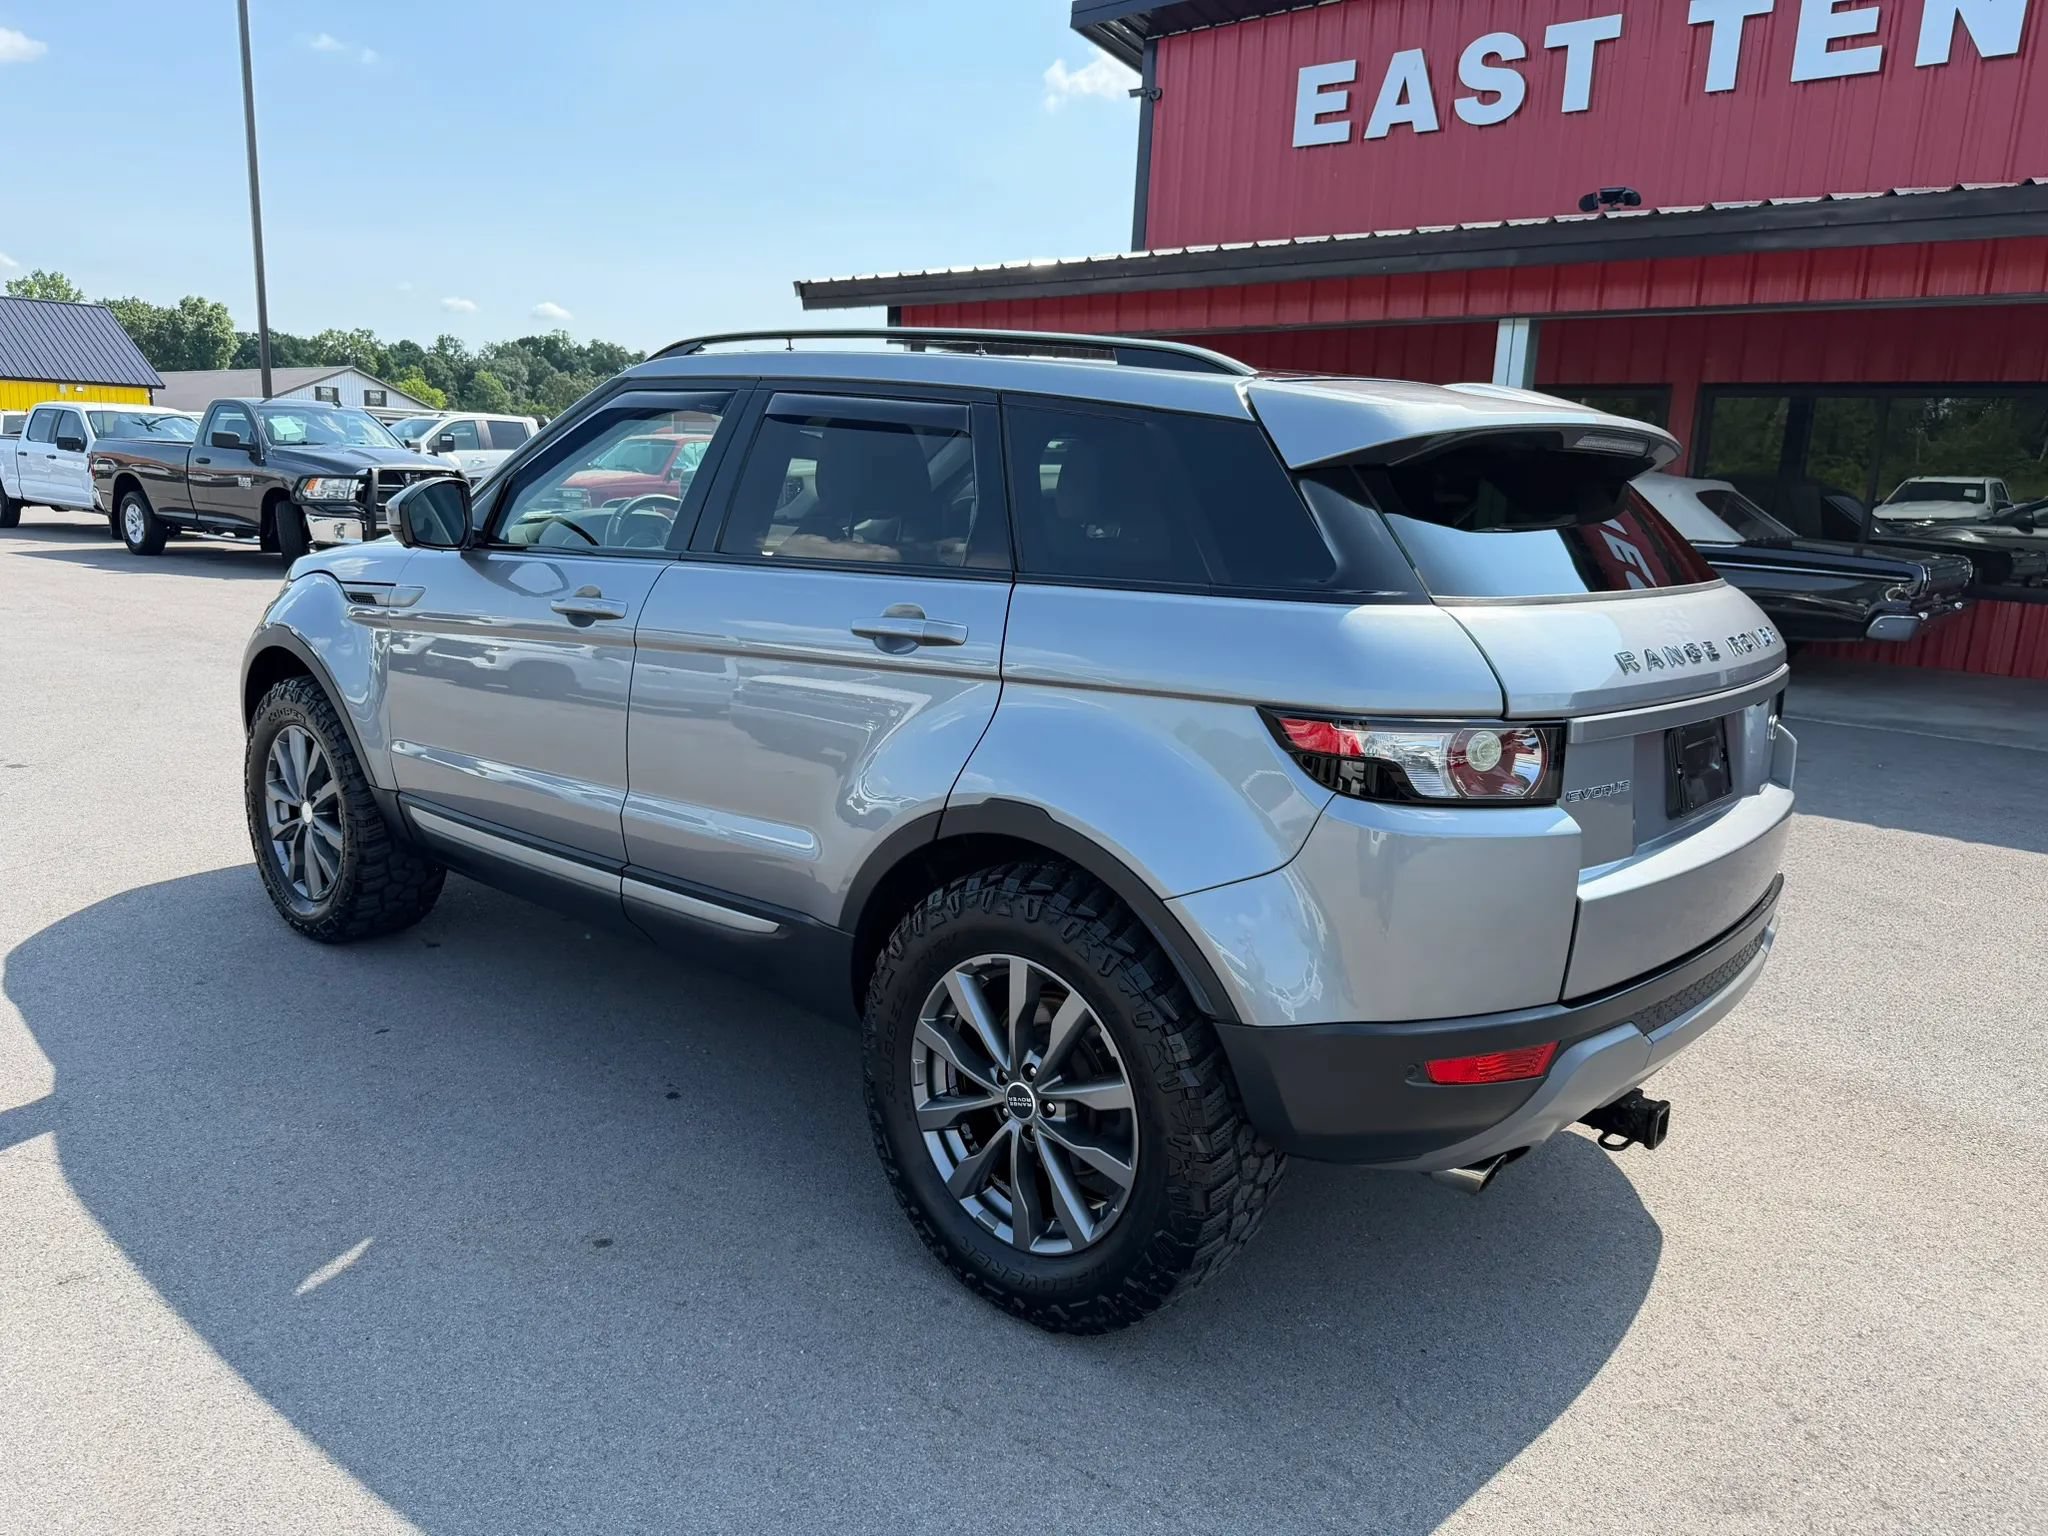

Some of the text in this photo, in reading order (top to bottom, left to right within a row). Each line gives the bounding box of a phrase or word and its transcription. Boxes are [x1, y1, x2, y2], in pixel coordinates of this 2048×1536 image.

[1292, 0, 2028, 148] EAST TEN
[1614, 626, 1777, 675] RANGE ROVER
[1566, 780, 1631, 802] EVOQUE
